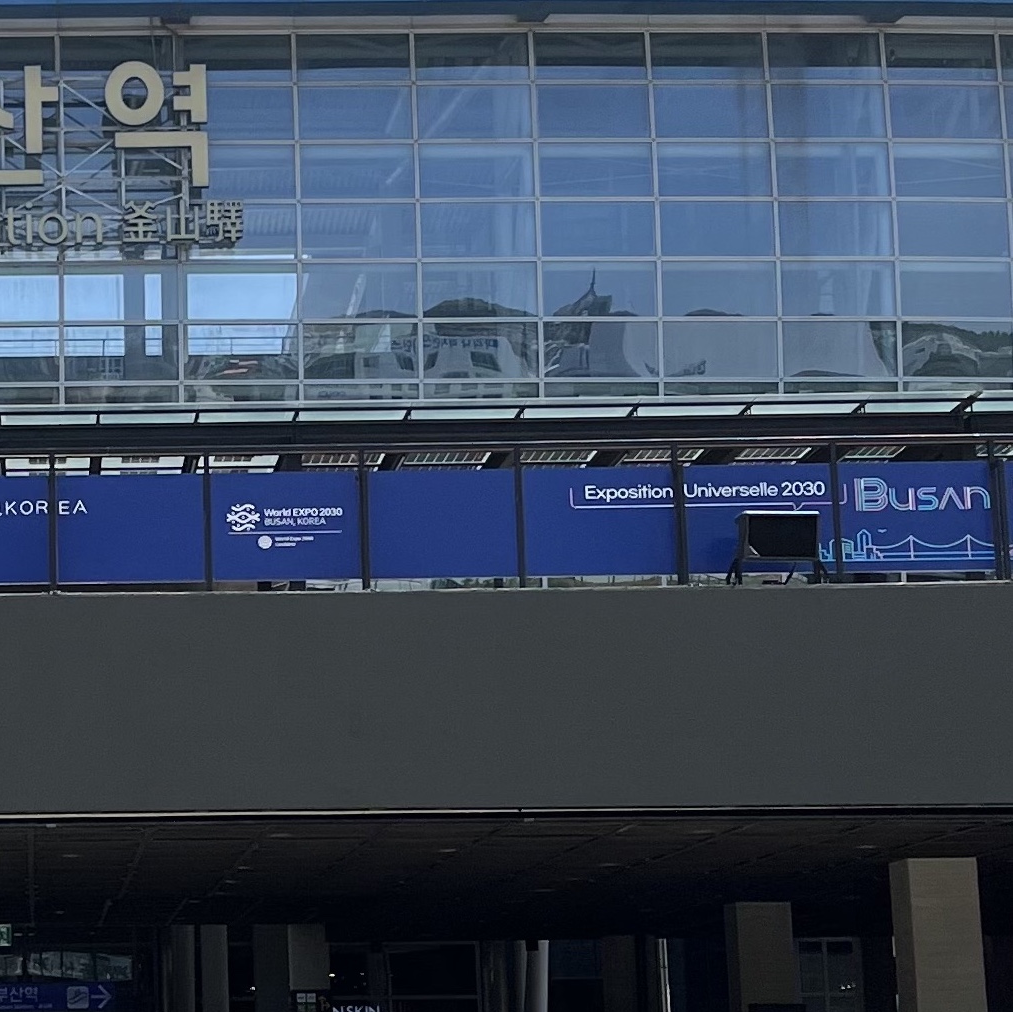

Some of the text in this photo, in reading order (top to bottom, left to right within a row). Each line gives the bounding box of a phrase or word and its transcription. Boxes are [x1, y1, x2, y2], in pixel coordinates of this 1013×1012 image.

[584, 480, 826, 503] Exposition Universelle 2030
[263, 507, 343, 517] World EXPO 2030
[297, 517, 327, 526] KOREA
